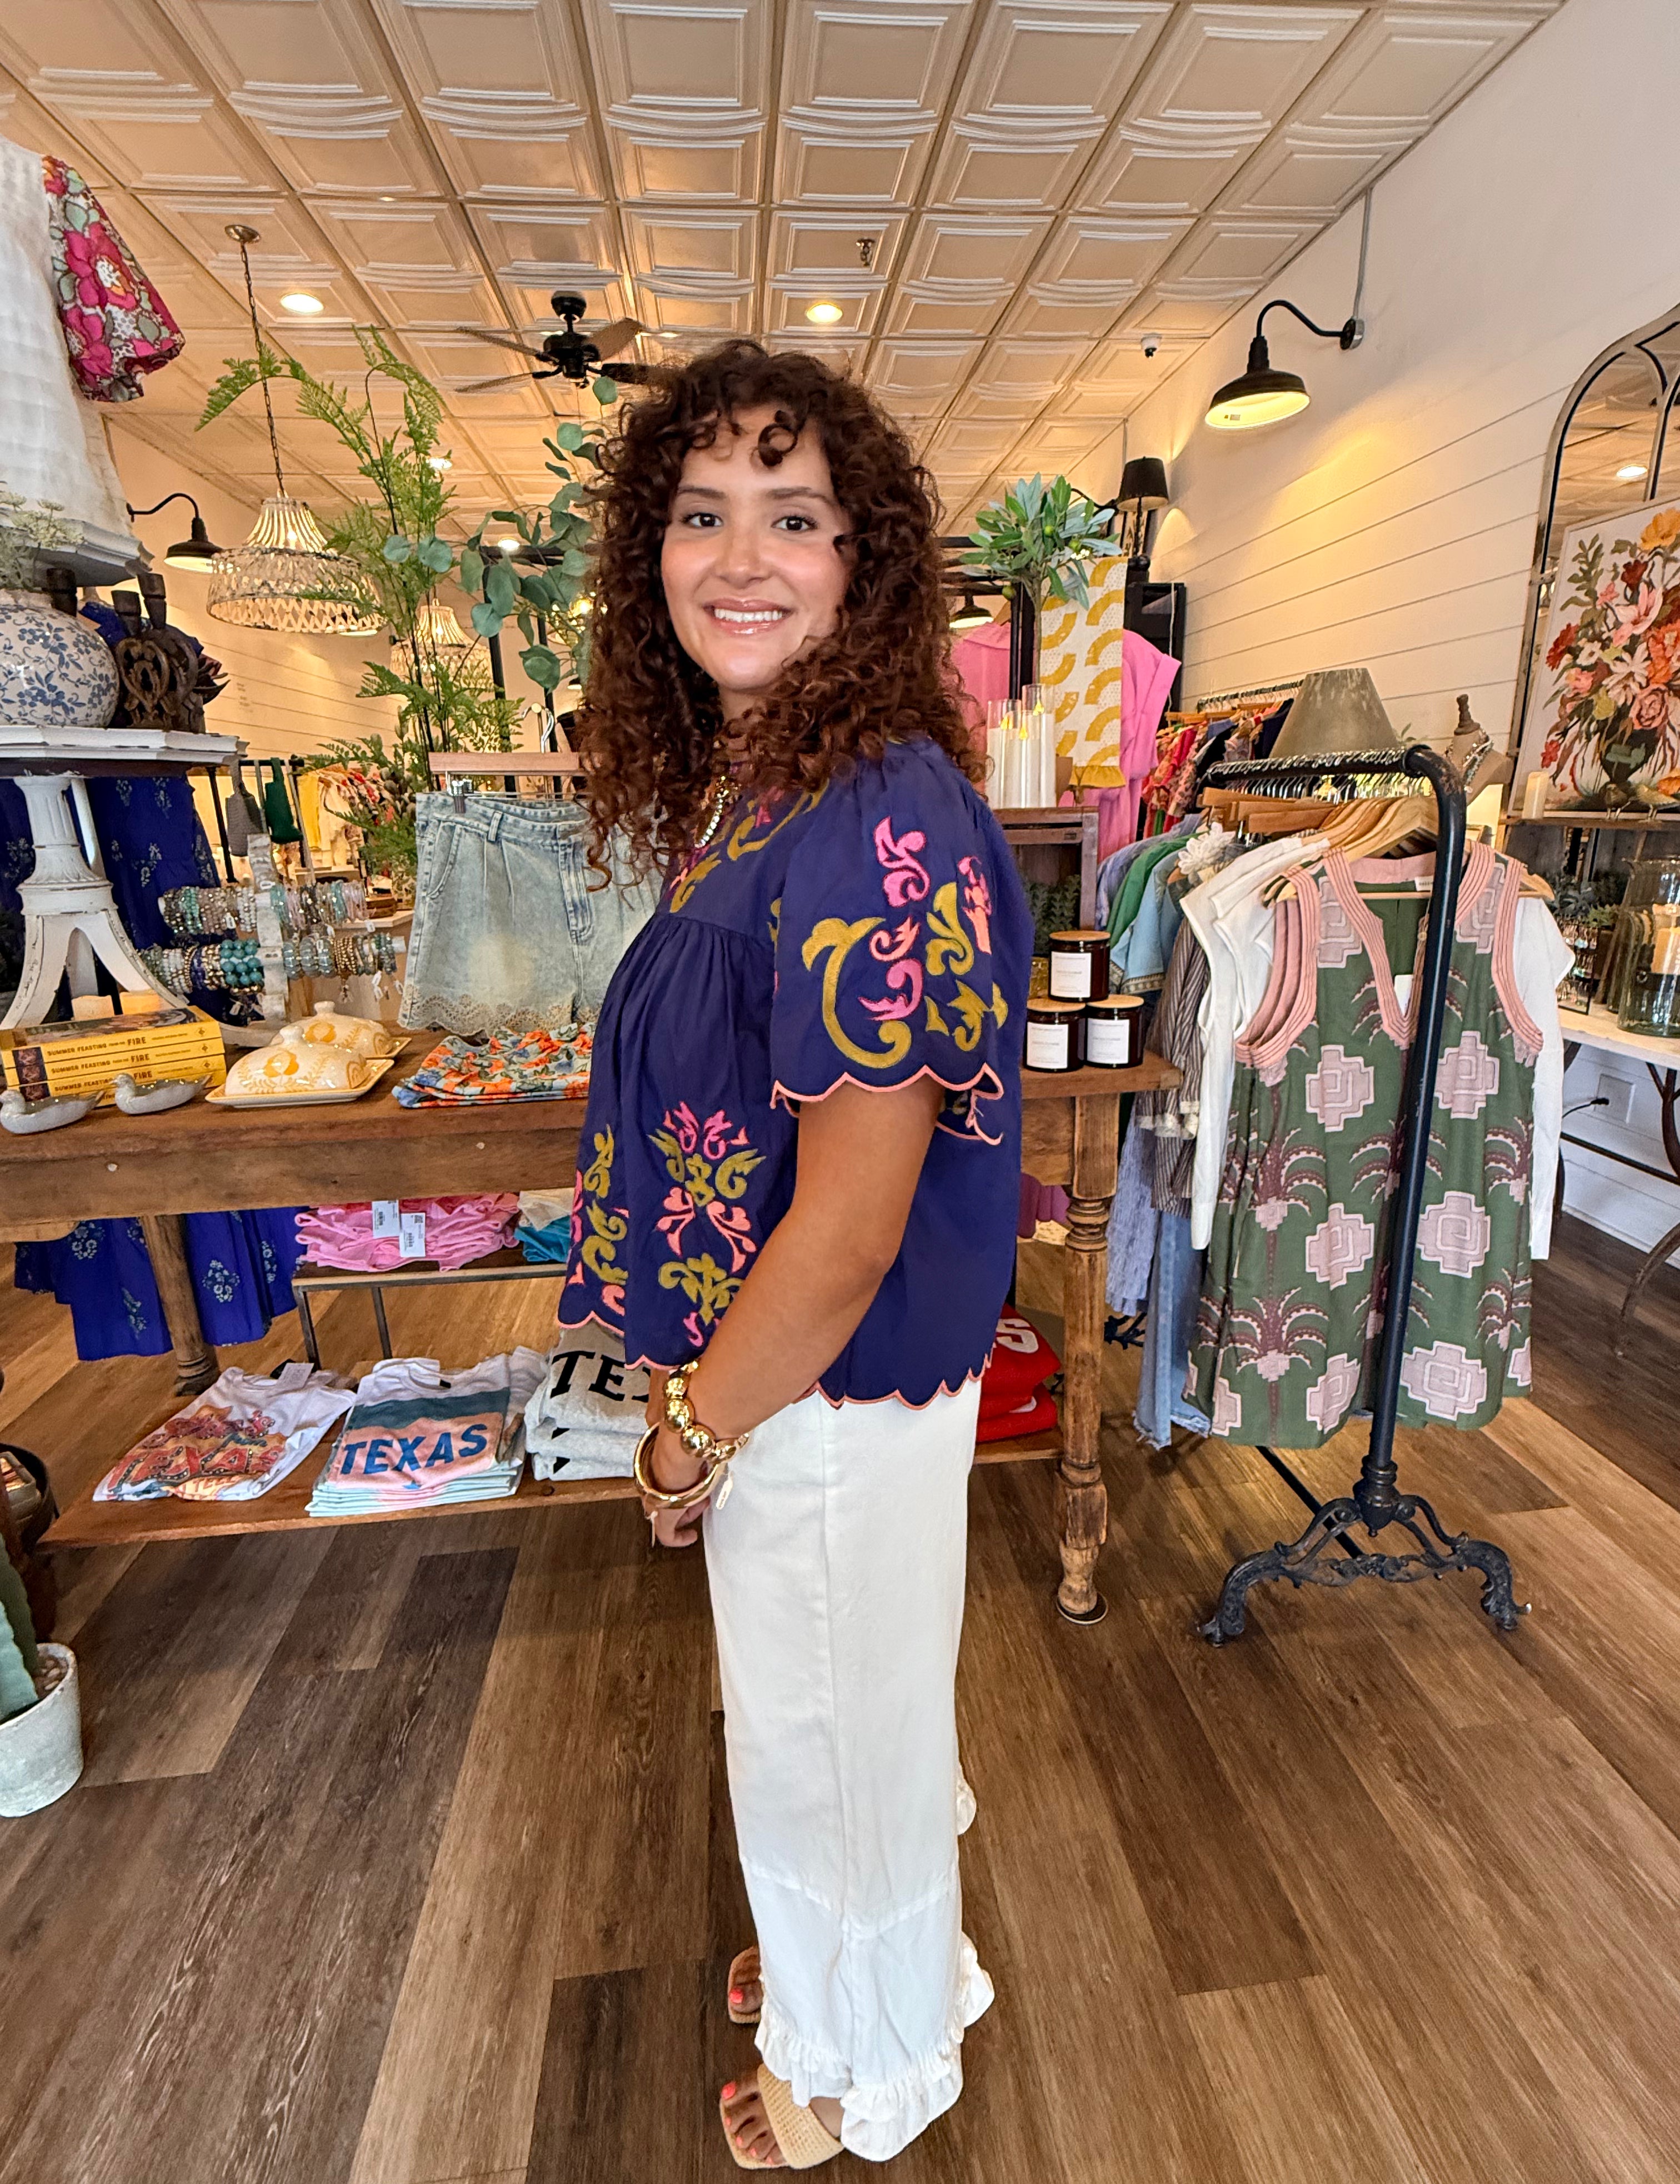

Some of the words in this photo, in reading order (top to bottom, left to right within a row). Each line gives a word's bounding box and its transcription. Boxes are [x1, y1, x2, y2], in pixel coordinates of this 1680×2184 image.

[47, 1047, 75, 1056] SUMMER
[77, 1043, 107, 1052] FEASTING
[127, 1036, 147, 1046] FIRE
[51, 1065, 79, 1074] SUMMER
[81, 1060, 111, 1069] FEASTING
[131, 1053, 150, 1063] FIRE
[54, 1083, 82, 1092] SUMMER
[133, 1071, 152, 1079] FIRE
[340, 1423, 487, 1475] TEXAS
